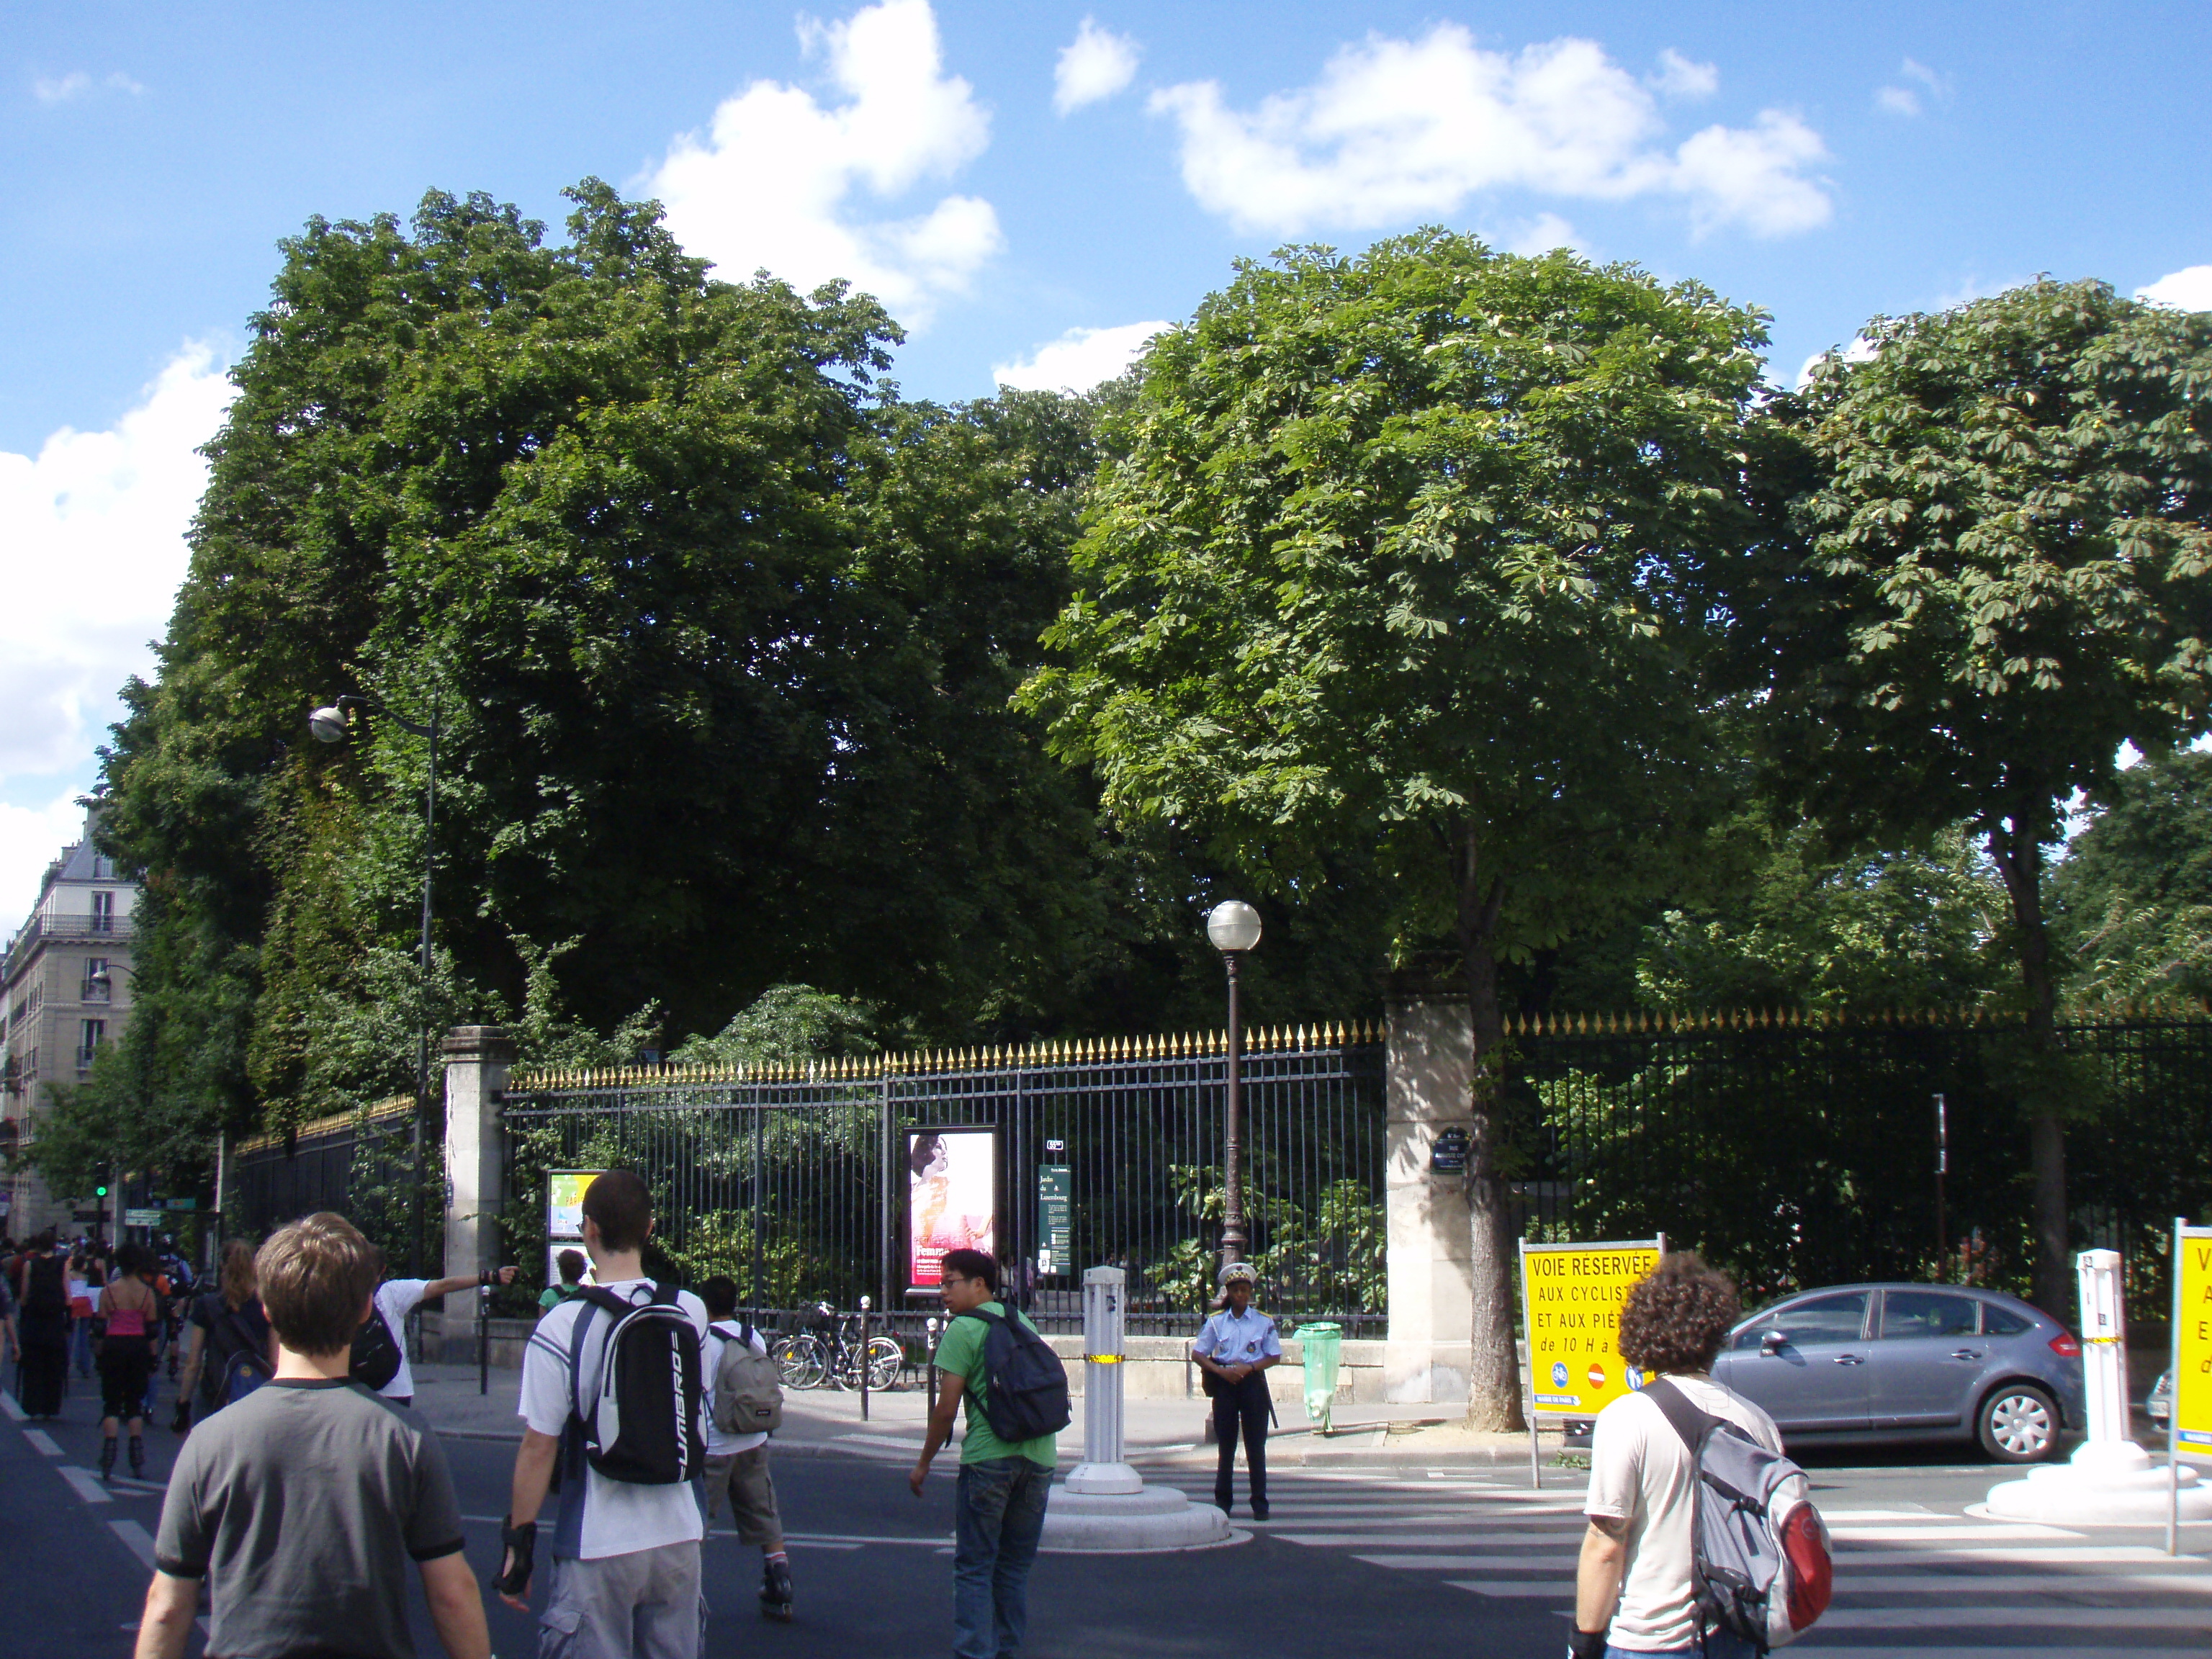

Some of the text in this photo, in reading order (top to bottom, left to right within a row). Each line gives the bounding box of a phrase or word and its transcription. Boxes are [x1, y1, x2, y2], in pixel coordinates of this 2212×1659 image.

[1532, 1251, 1651, 1277] VOIE RÉSERVÉE
[1538, 1286, 1564, 1302] AUX
[1537, 1313, 1552, 1328] ET
[1560, 1313, 1586, 1328] AUX
[1541, 1337, 1609, 1353] de 10 H à
[672, 1350, 688, 1467] UMBRO
